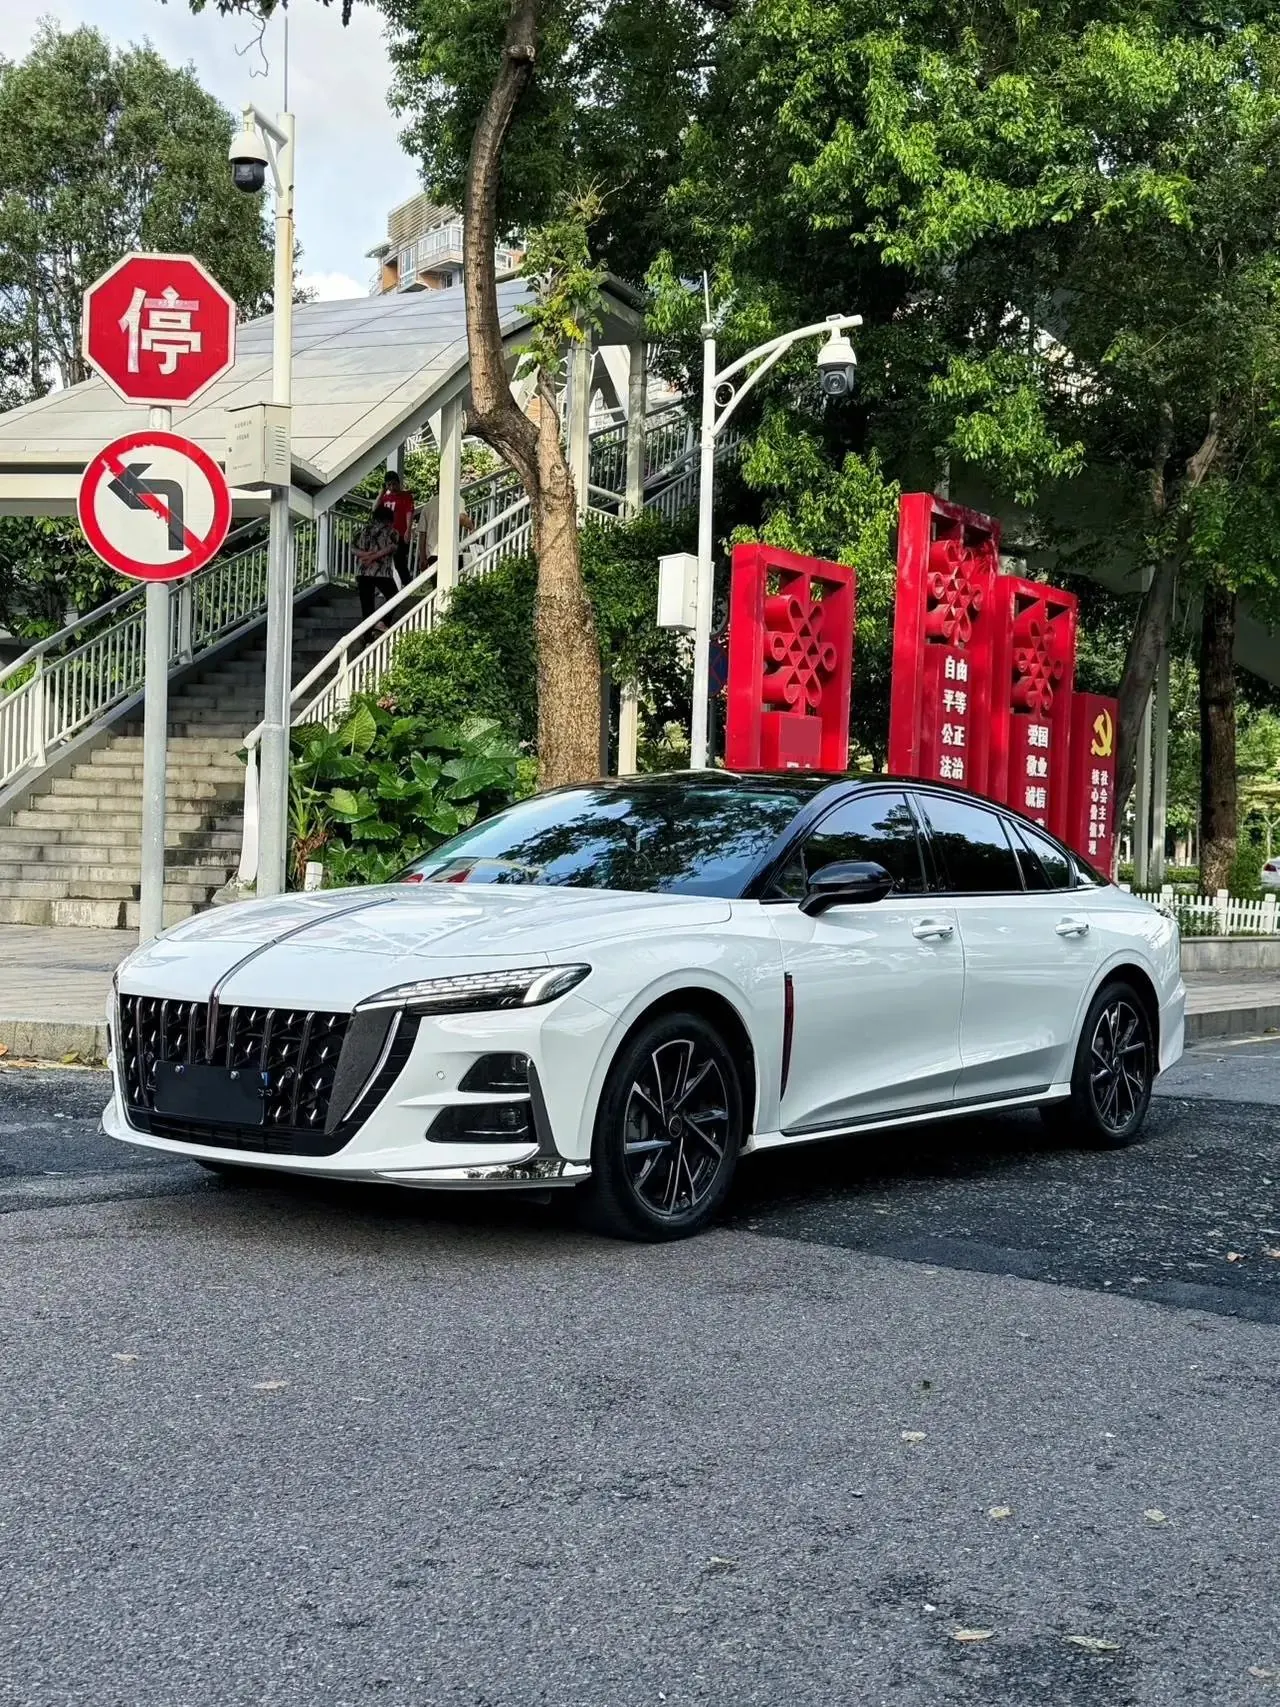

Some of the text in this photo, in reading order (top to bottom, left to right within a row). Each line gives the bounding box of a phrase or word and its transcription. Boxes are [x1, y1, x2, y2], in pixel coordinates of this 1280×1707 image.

[117, 285, 202, 375] 停
[944, 655, 968, 682] 自由
[942, 689, 967, 715] 平等
[941, 723, 965, 747] 公正
[1027, 724, 1048, 748] 爱国
[940, 755, 964, 780] 法治
[1026, 755, 1048, 778] 敬业
[1025, 786, 1047, 809] 诚信
[1098, 770, 1108, 838] 社会主义
